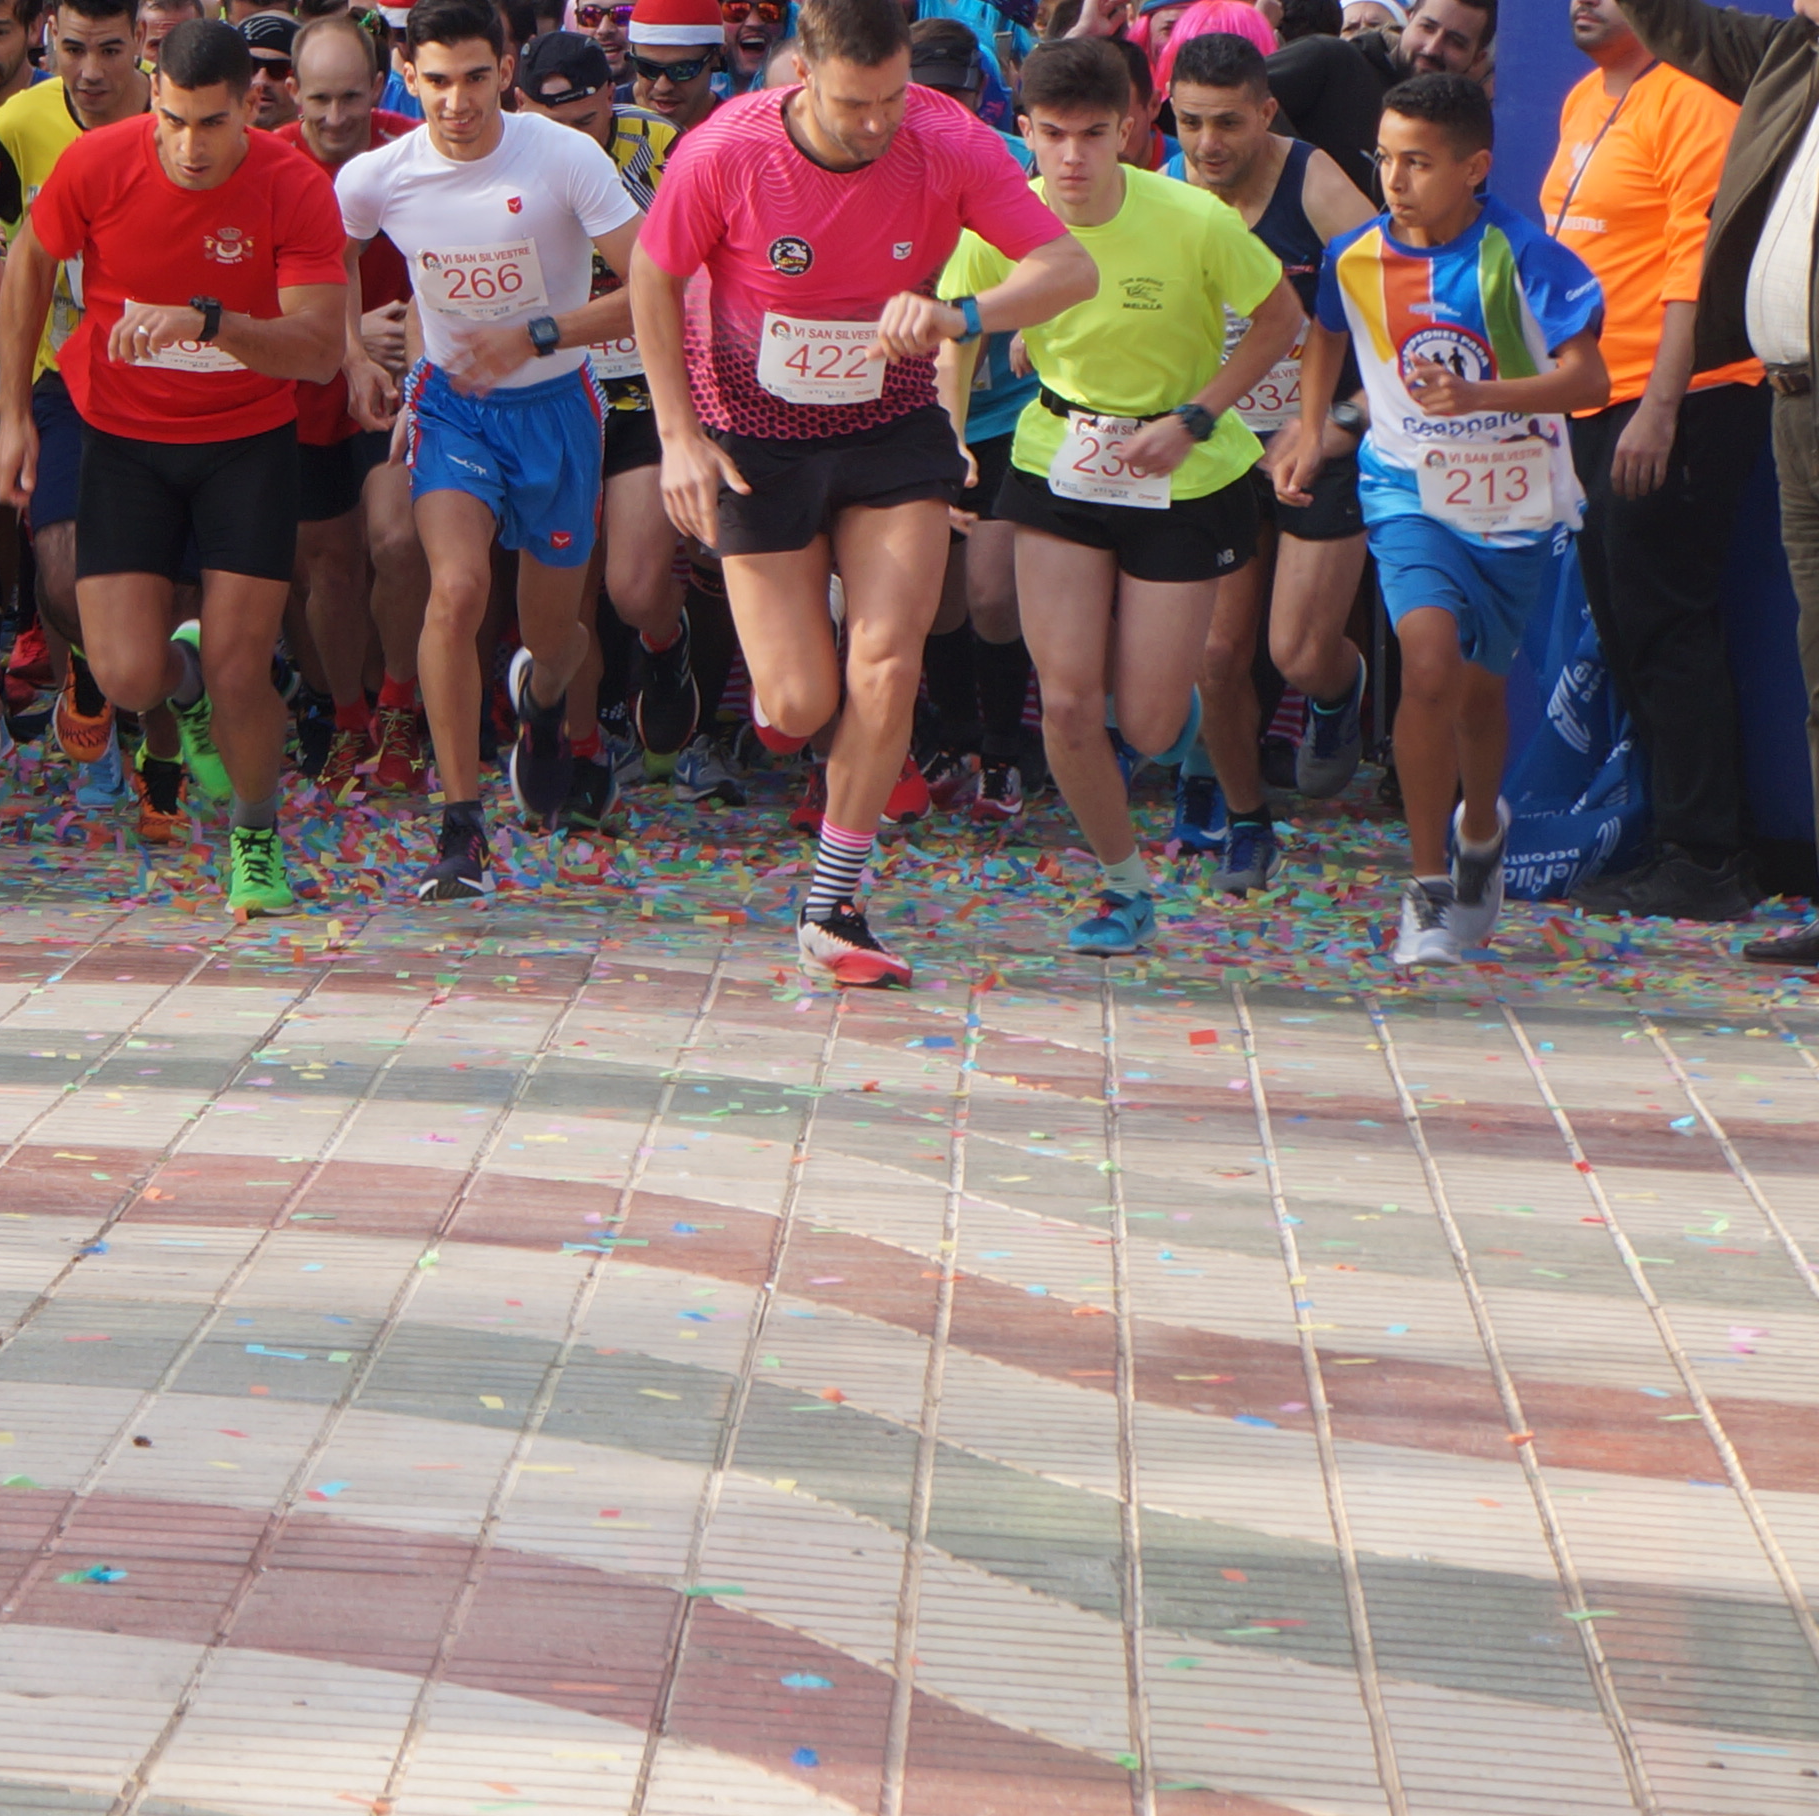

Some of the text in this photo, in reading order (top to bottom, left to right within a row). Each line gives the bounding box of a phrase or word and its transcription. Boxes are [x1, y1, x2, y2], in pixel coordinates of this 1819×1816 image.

[441, 246, 531, 264] VI SAN SILVESTRE
[443, 263, 522, 299] 266
[794, 326, 878, 340] VI SAN SILVEST
[784, 344, 869, 379] 422
[1449, 447, 1544, 464] VI SAN SILVESTRE
[1445, 466, 1530, 505] 213
[1216, 548, 1235, 566] NB
